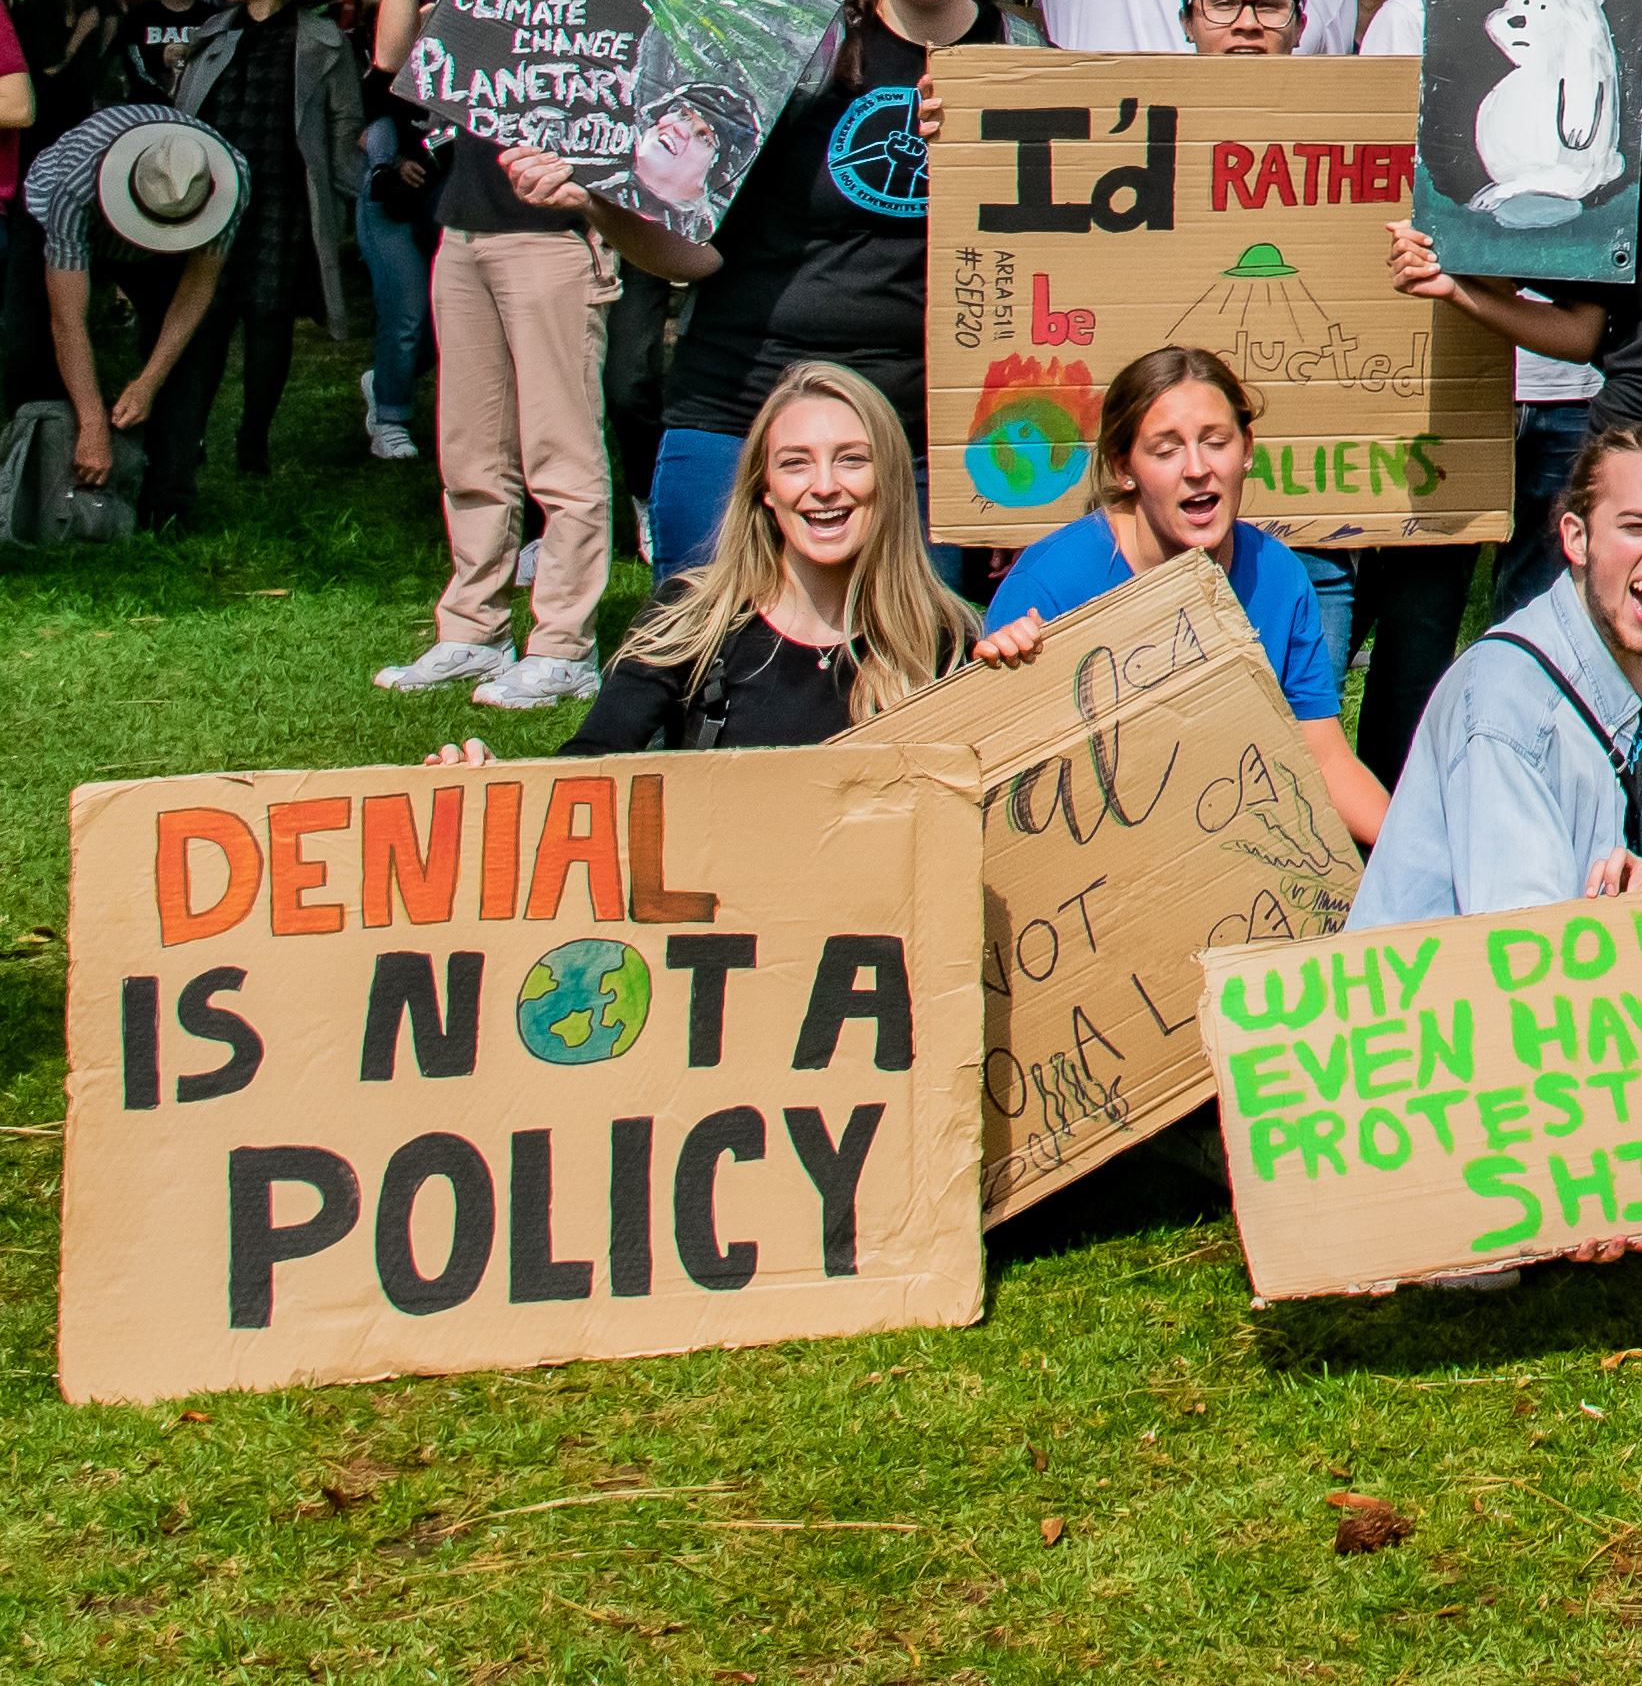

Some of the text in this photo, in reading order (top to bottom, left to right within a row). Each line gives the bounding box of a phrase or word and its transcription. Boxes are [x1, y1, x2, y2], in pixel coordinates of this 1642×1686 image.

[410, 36, 643, 111] PLANETARY
[510, 27, 634, 61] CHANGE
[876, 93, 904, 102] NOW
[977, 98, 1178, 233] I'd
[955, 246, 986, 349] #SEP20
[994, 250, 1016, 300] AREA
[1031, 272, 1096, 346] be
[1213, 321, 1429, 398] ducted
[1247, 433, 1446, 497] ALIENS
[155, 774, 719, 947] DENIAL
[122, 966, 264, 1110] IS
[792, 934, 914, 1072] A
[1221, 936, 1441, 1031] WHY
[1487, 916, 1616, 992] DO
[1229, 998, 1473, 1115] EVEN
[1249, 1067, 1641, 1180] PROTEST
[228, 1102, 887, 1330] POLICY
